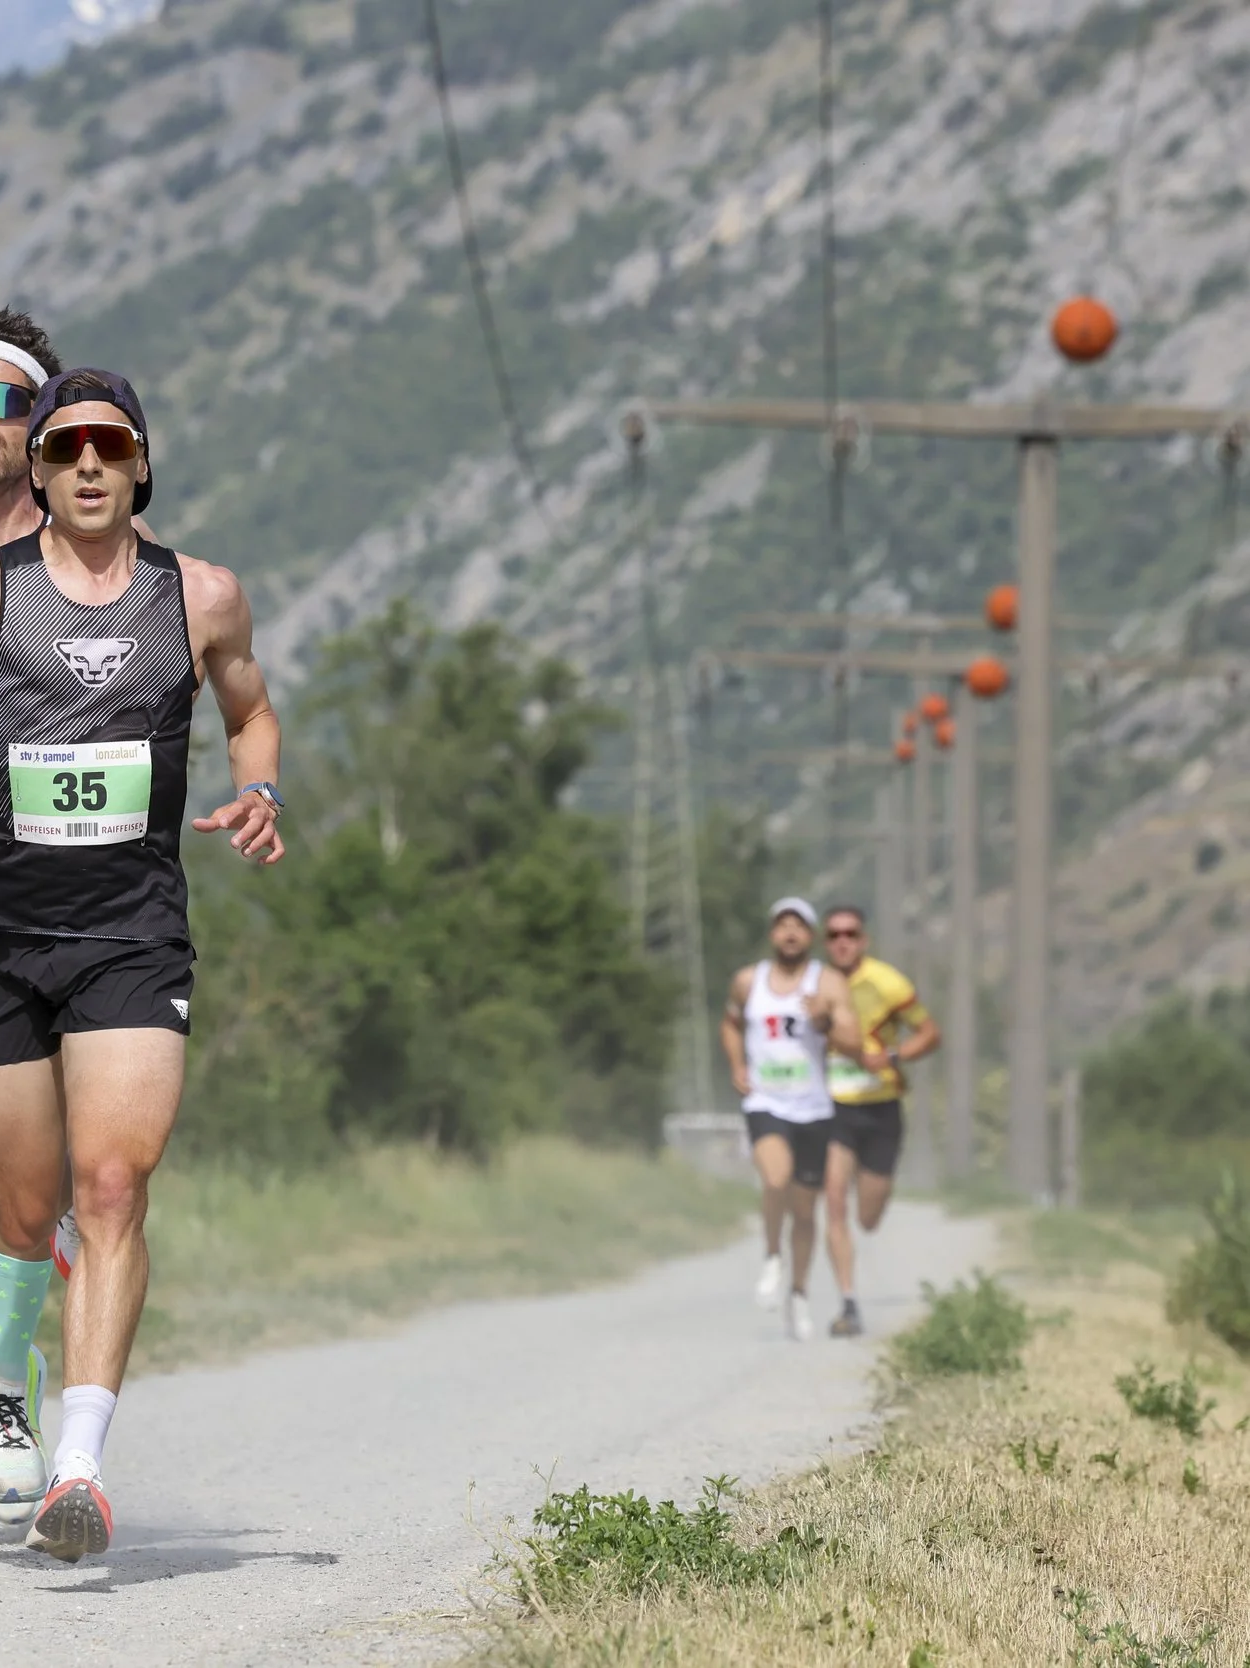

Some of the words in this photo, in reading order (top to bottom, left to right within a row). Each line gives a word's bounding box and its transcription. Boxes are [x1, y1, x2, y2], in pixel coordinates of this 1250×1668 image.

[20, 751, 32, 761] stv
[43, 751, 75, 763] gampel
[95, 747, 138, 760] lonzalauf
[52, 771, 108, 812] 35
[18, 823, 61, 835] RAIFFEISEN
[101, 821, 144, 834] RAIFFEISEN
